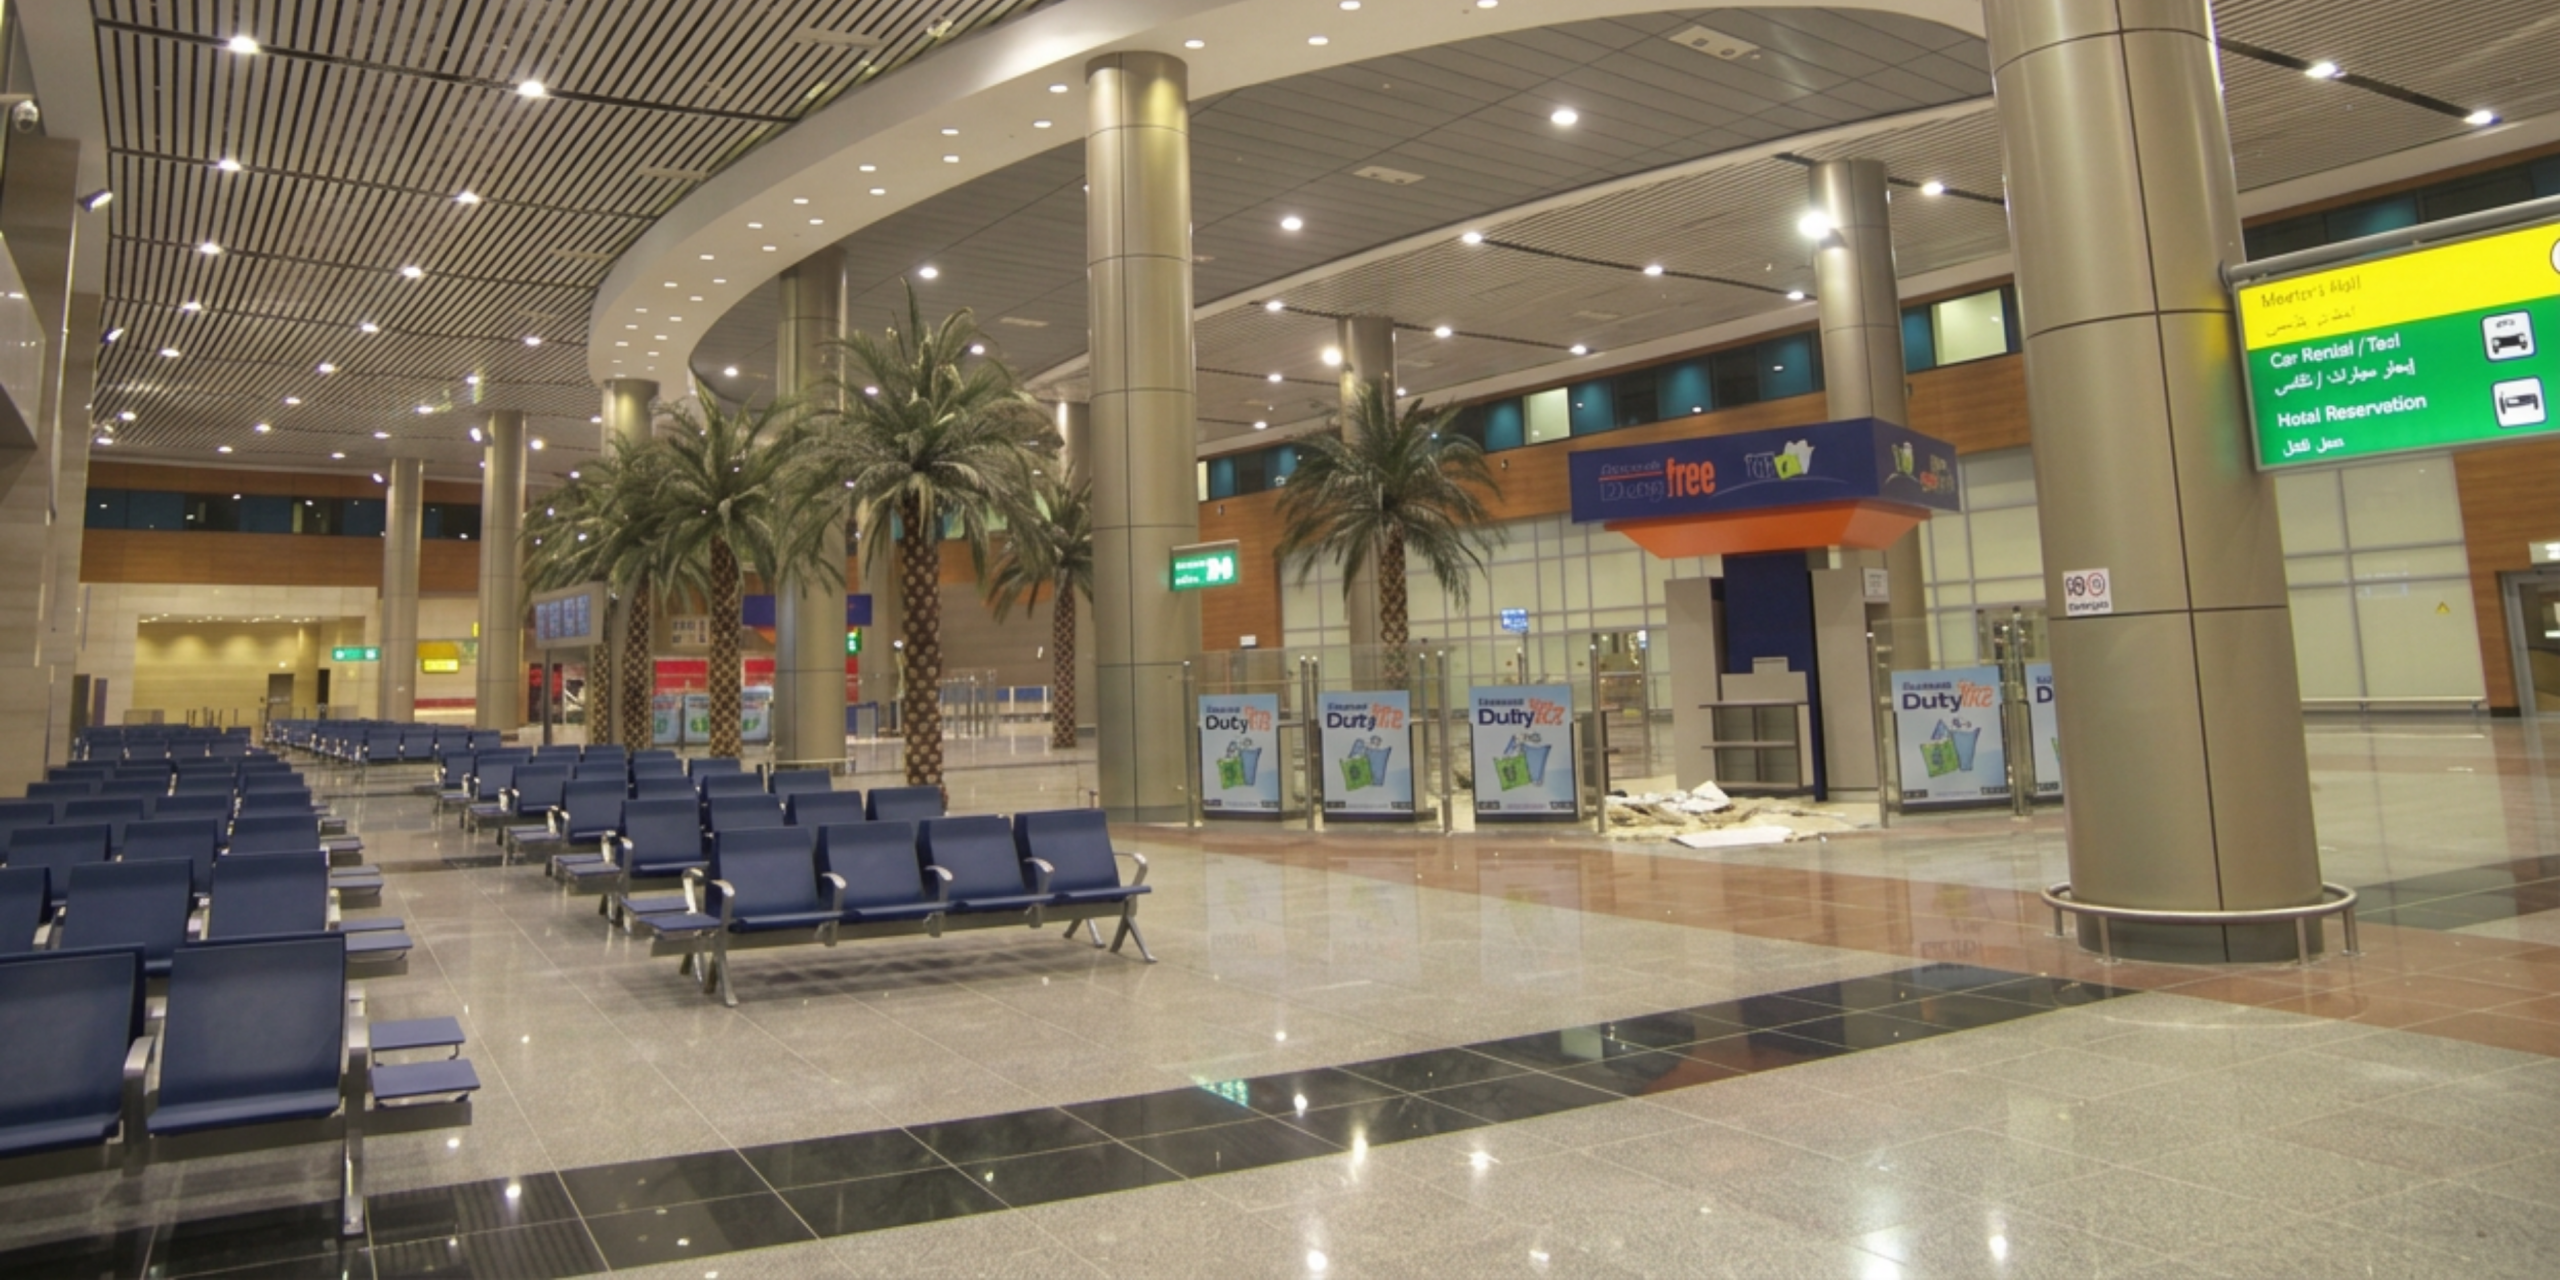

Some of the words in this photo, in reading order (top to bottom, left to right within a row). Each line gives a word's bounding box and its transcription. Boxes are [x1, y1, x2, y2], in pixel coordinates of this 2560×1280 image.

[2270, 351, 2298, 369] Car
[1665, 457, 1715, 497] free
[1903, 692, 1963, 713] Duty
[1206, 714, 1248, 734] Duty
